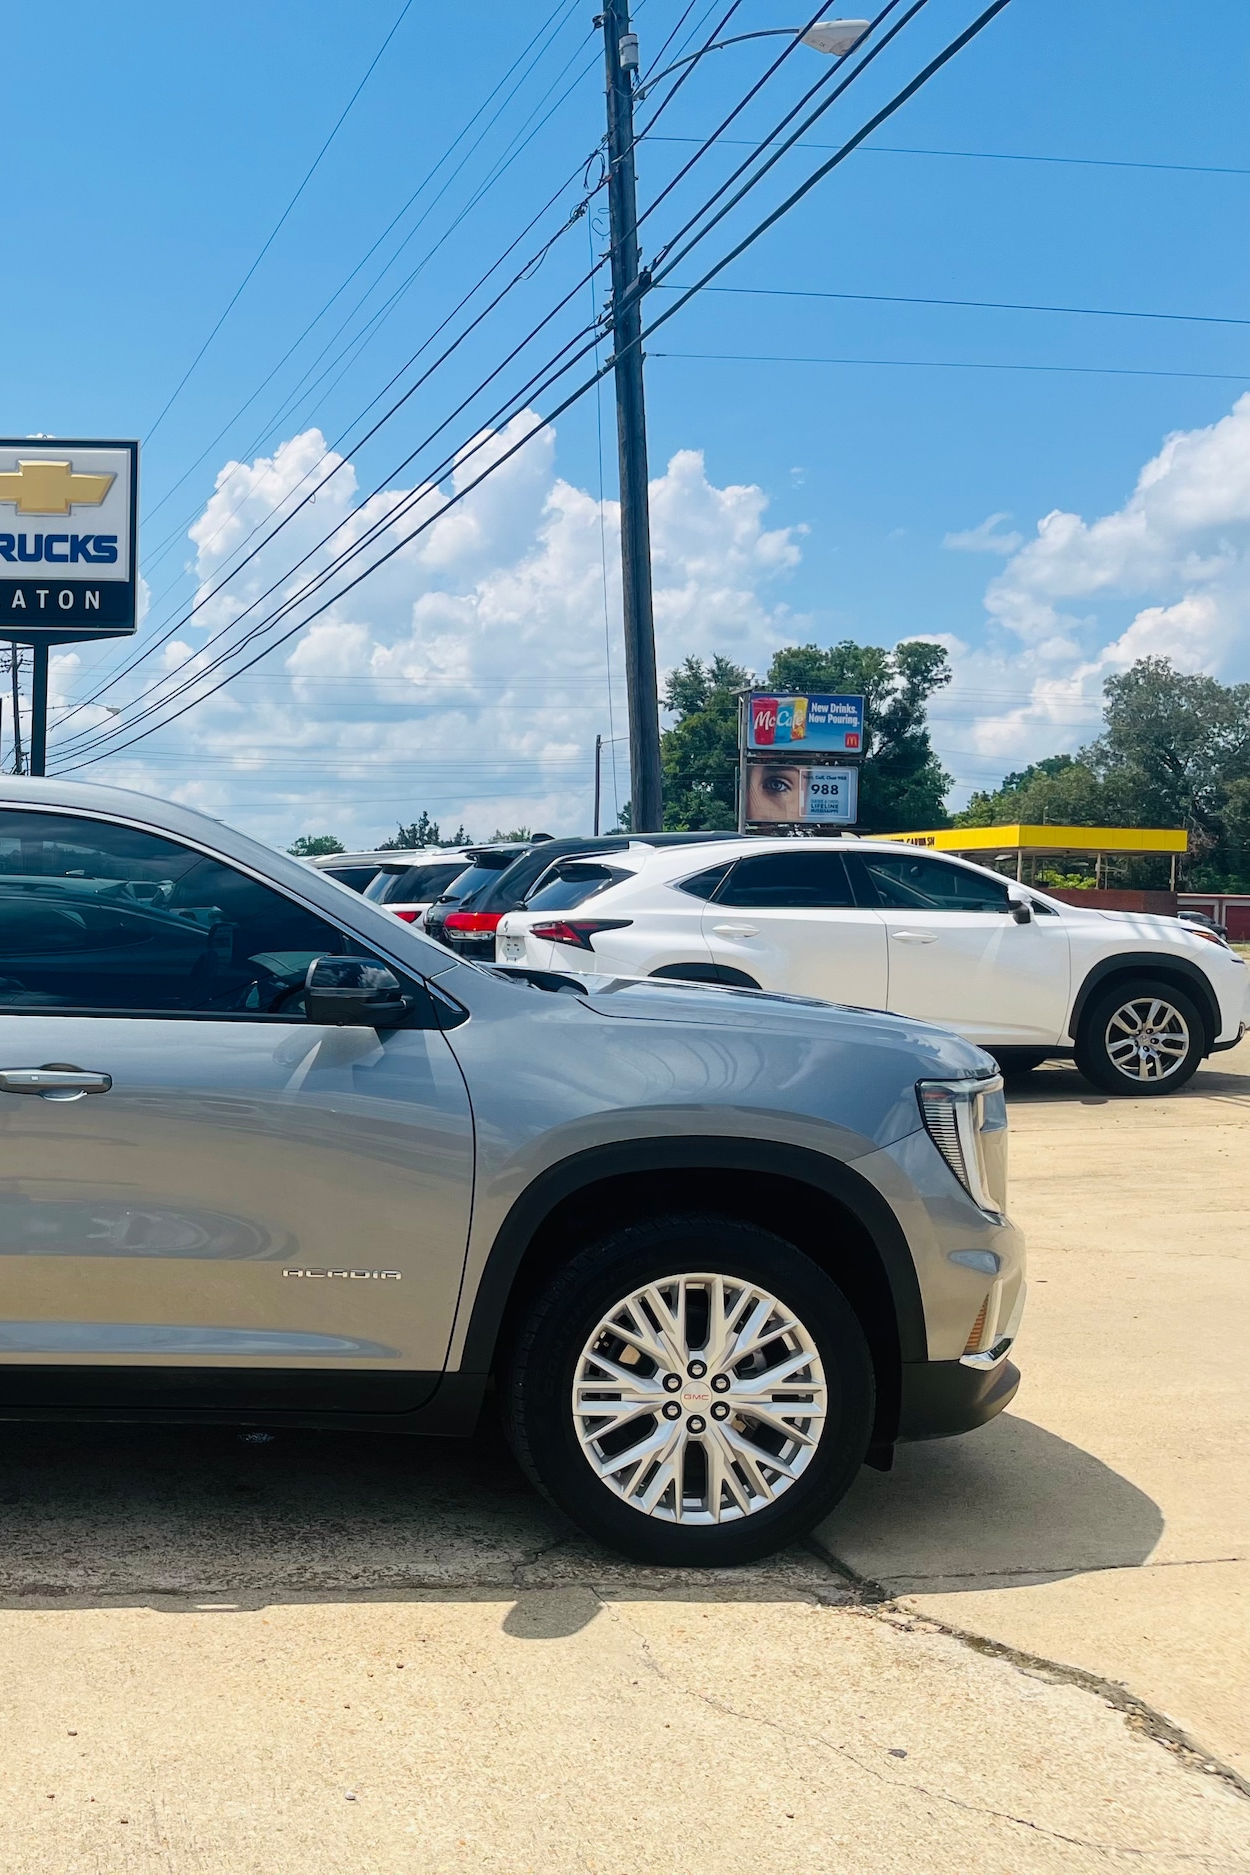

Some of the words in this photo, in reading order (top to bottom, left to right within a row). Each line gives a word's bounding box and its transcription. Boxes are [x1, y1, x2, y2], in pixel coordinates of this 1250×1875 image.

[811, 702, 829, 713] New
[830, 703, 858, 714] Drinks.
[808, 713, 827, 724] Now
[827, 713, 860, 727] Pouring.
[811, 784, 839, 795] 988
[282, 1268, 402, 1280] ACADIA
[683, 1393, 709, 1401] GMC
